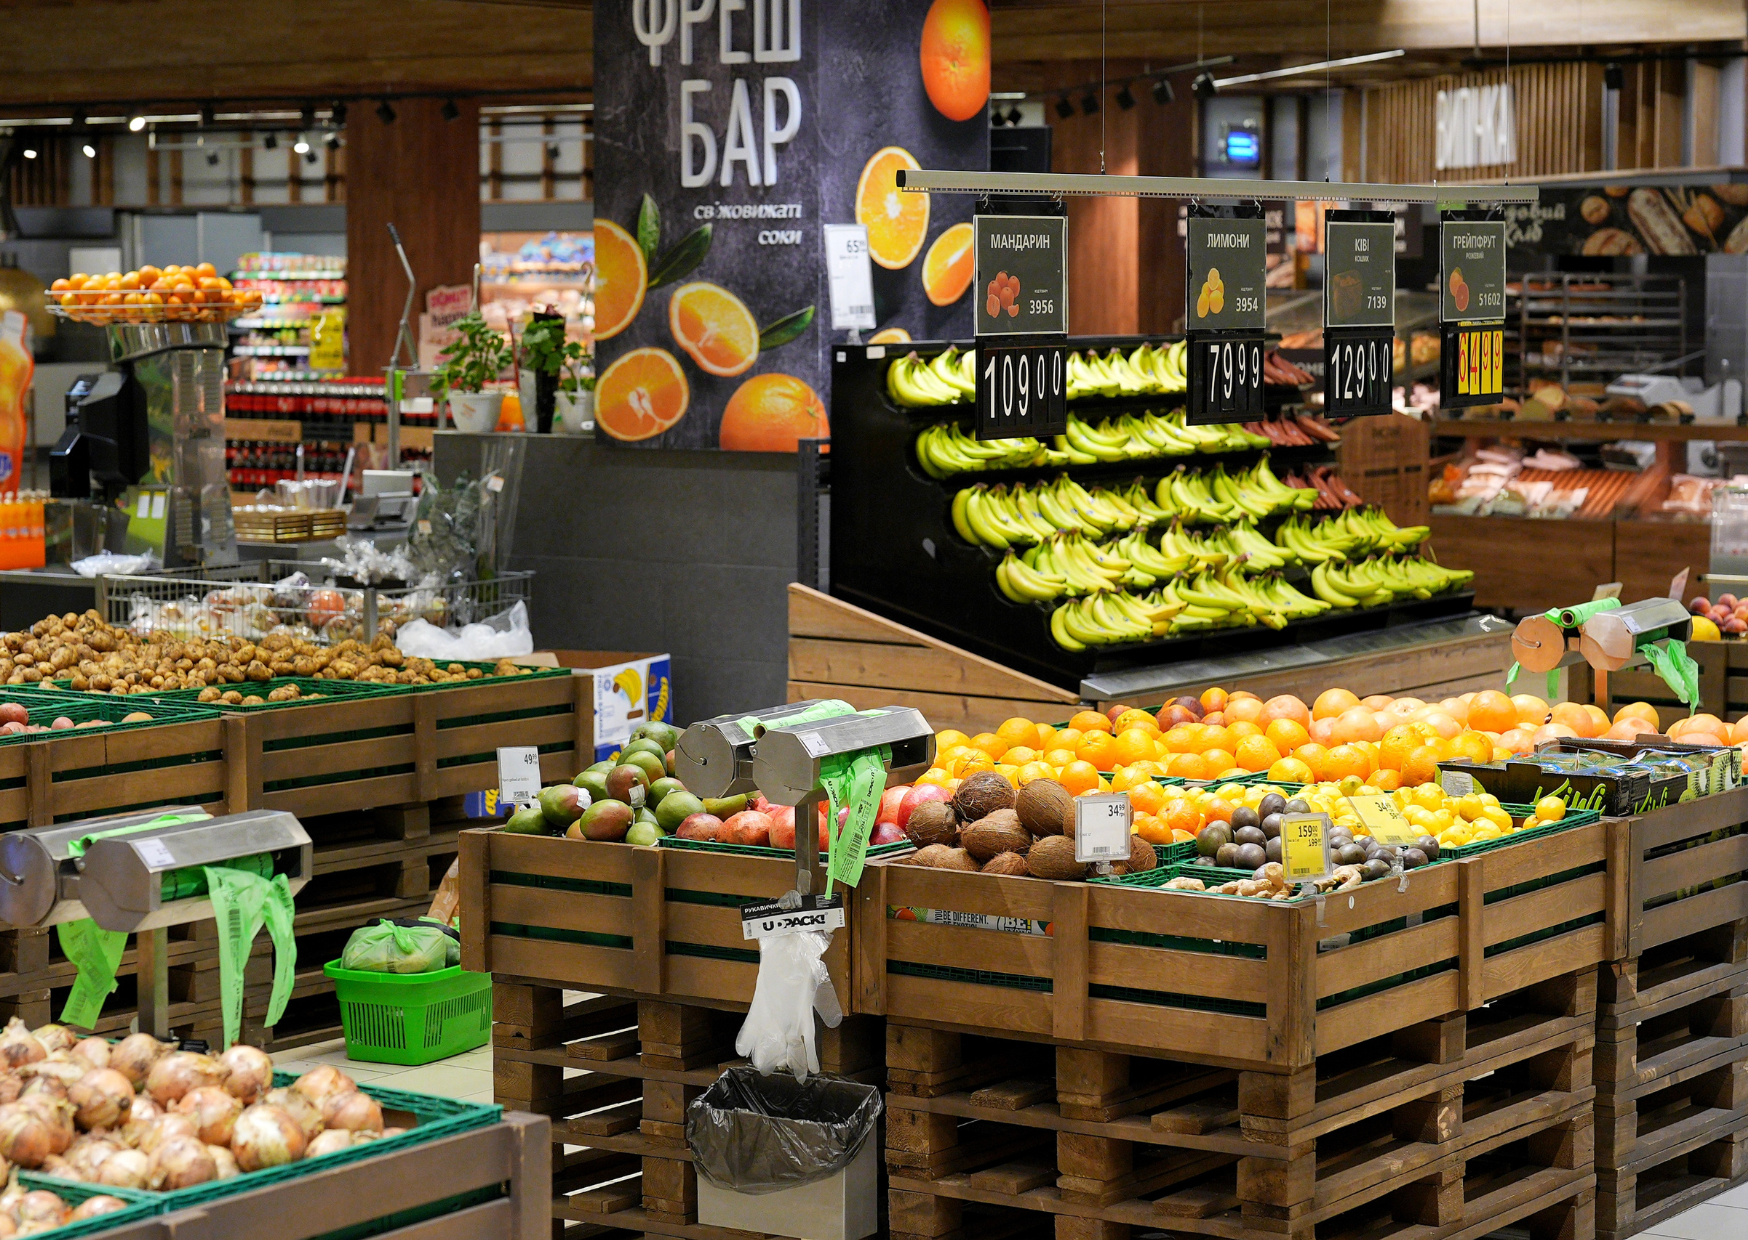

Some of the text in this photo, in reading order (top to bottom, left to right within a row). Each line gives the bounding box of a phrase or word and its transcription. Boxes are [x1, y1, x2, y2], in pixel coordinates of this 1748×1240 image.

[632, 0, 802, 67] ФРЕШ
[680, 77, 802, 188] БАР
[758, 229, 802, 245] соки
[990, 233, 1051, 252] МАНДАРИН
[1207, 233, 1250, 249] ЛИМОНИ
[1354, 238, 1370, 252] КІВІ
[1453, 232, 1497, 249] ГРЕЙПФРУТ
[1029, 299, 1054, 315] 3956
[1235, 297, 1258, 312] 3954
[1367, 296, 1387, 309] 7139
[1478, 293, 1501, 306] 51602
[943, 910, 951, 921] BE
[952, 911, 989, 925] DIFFERENT.
